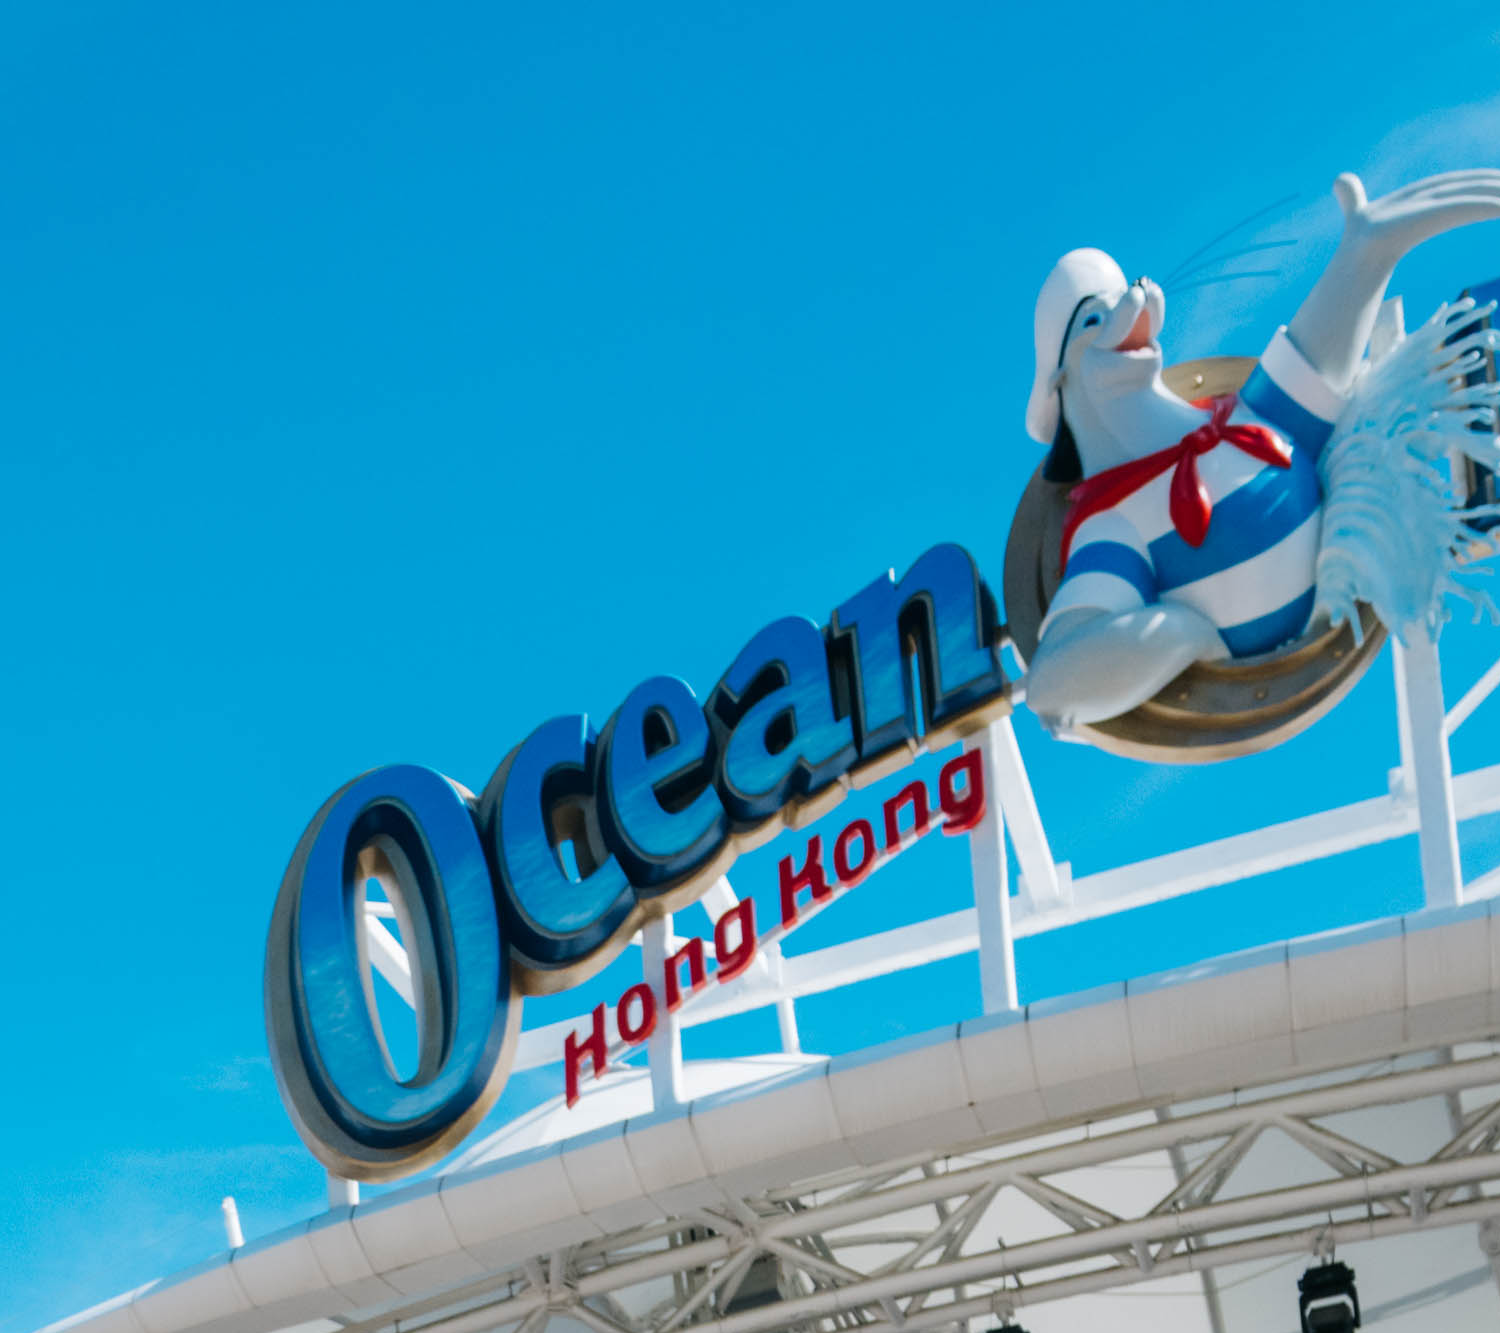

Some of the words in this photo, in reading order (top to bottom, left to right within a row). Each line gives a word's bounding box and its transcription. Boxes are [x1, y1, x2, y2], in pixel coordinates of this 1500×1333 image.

[264, 543, 1003, 1178] Ocean
[565, 896, 758, 1109] Hong
[778, 747, 985, 929] Kong
